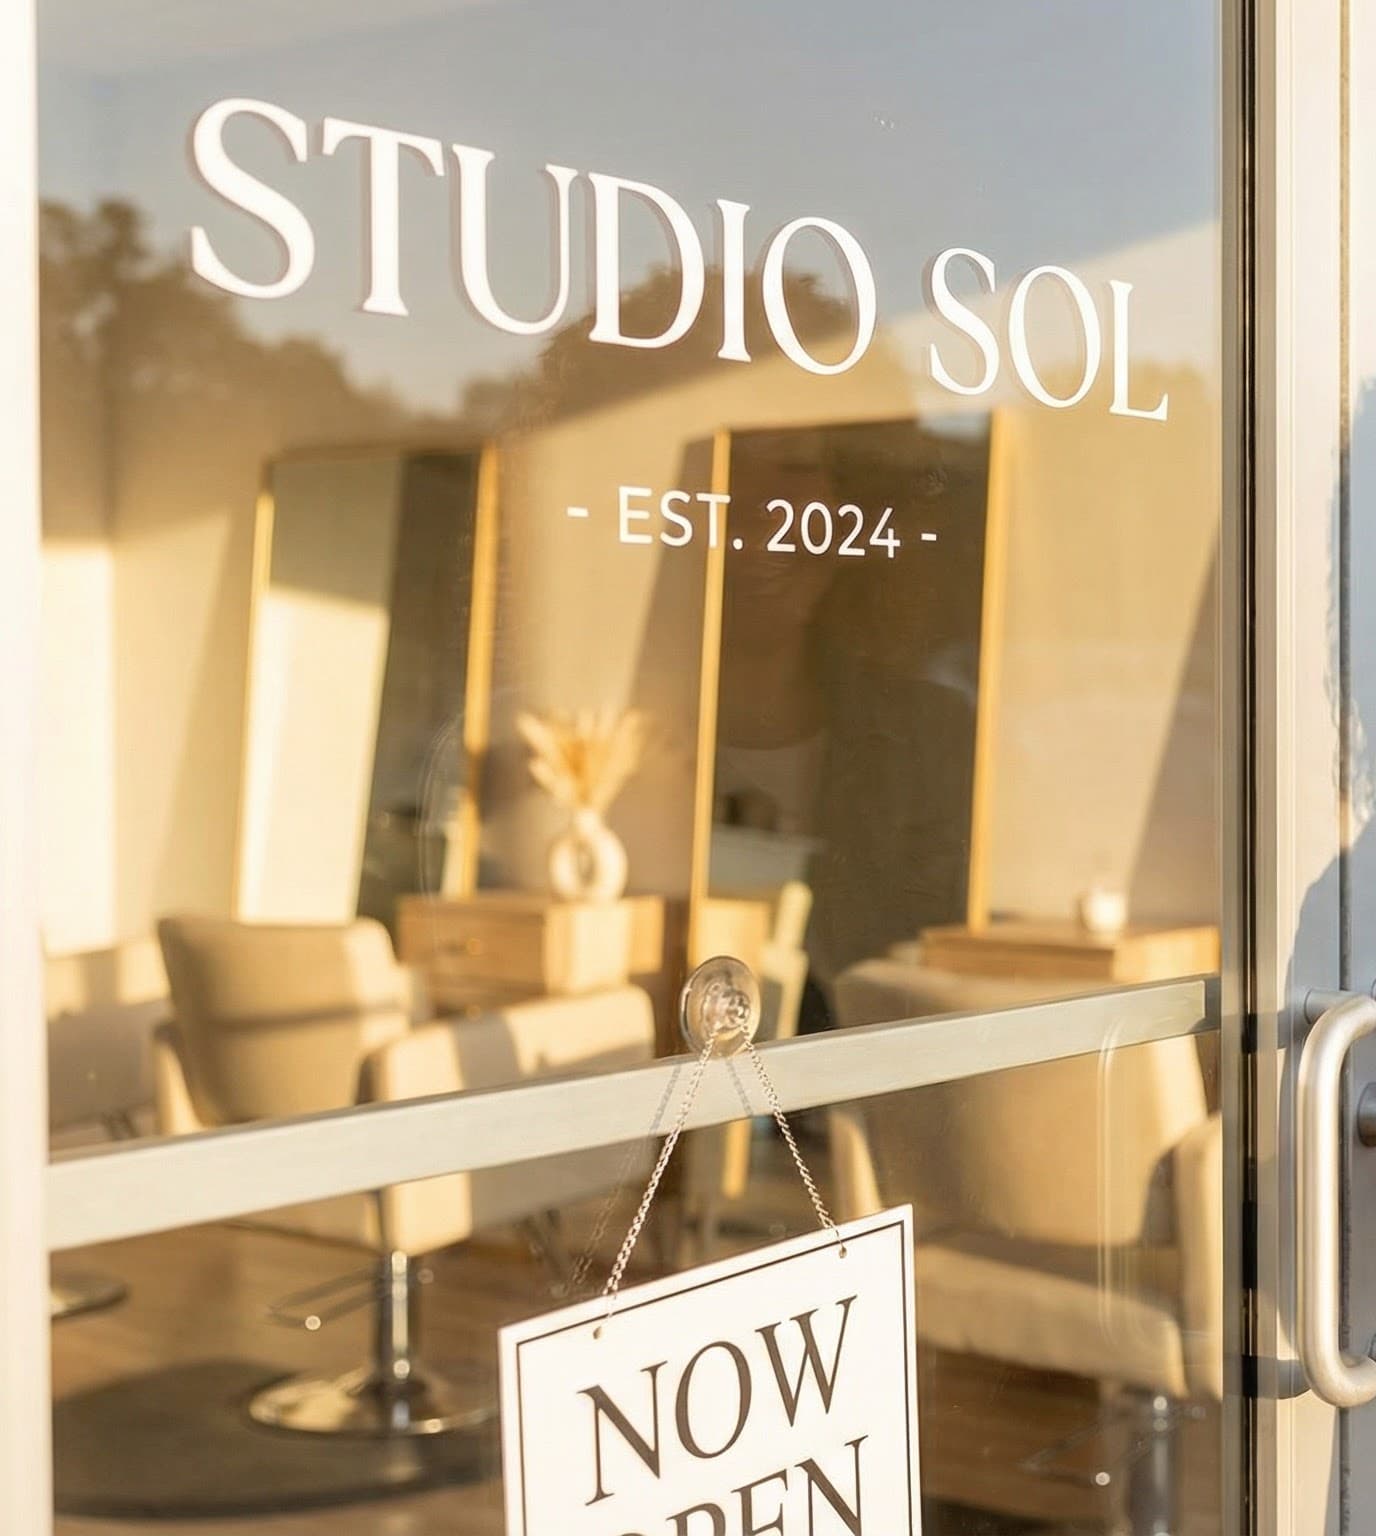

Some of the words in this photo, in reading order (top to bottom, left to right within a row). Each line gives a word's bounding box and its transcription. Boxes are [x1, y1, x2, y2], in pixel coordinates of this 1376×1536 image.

[192, 98, 877, 375] STUDIO
[929, 246, 1168, 421] SOL
[618, 485, 744, 550] EST.
[766, 498, 901, 558] 2024
[576, 1294, 858, 1506] NOW
[619, 1434, 869, 1536] EN
